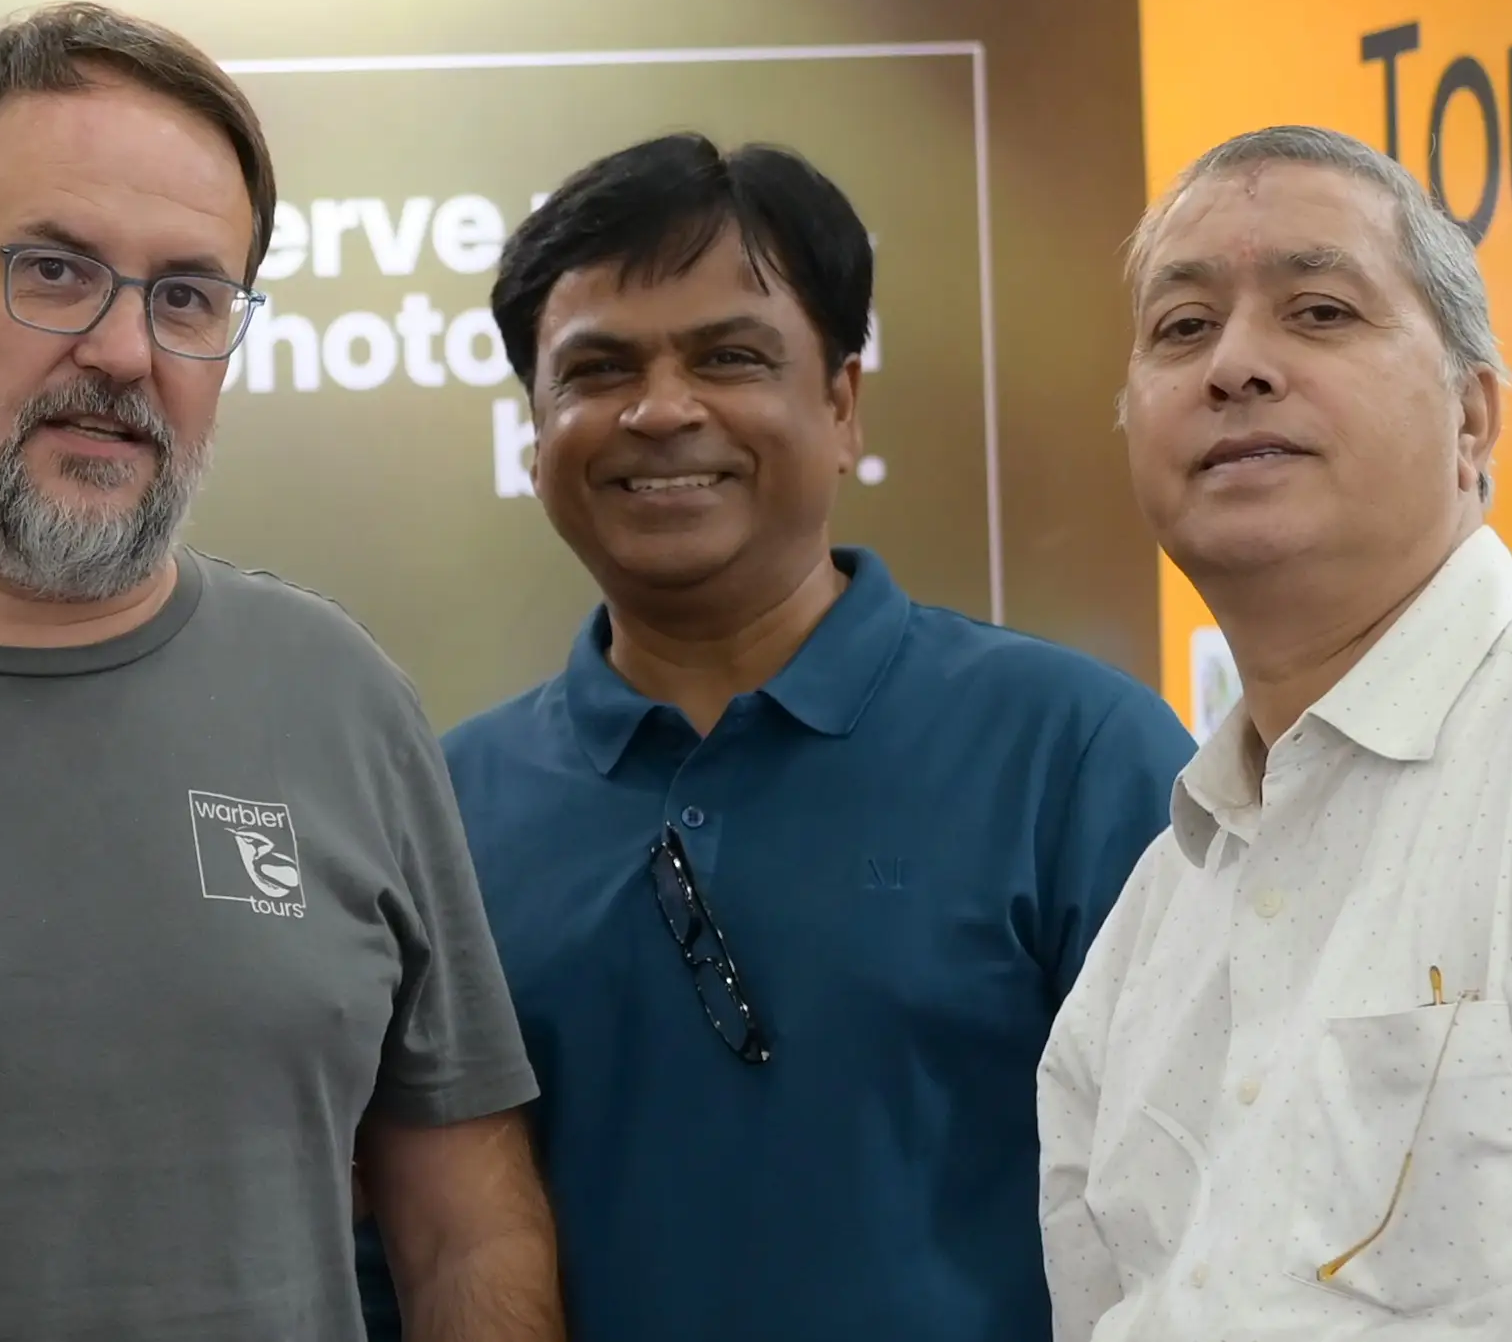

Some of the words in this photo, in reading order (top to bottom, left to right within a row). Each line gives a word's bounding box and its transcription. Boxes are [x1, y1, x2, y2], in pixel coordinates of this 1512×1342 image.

[257, 193, 507, 280] erve
[221, 292, 514, 394] hoto
[194, 800, 285, 828] warbler
[249, 895, 305, 919] tours
